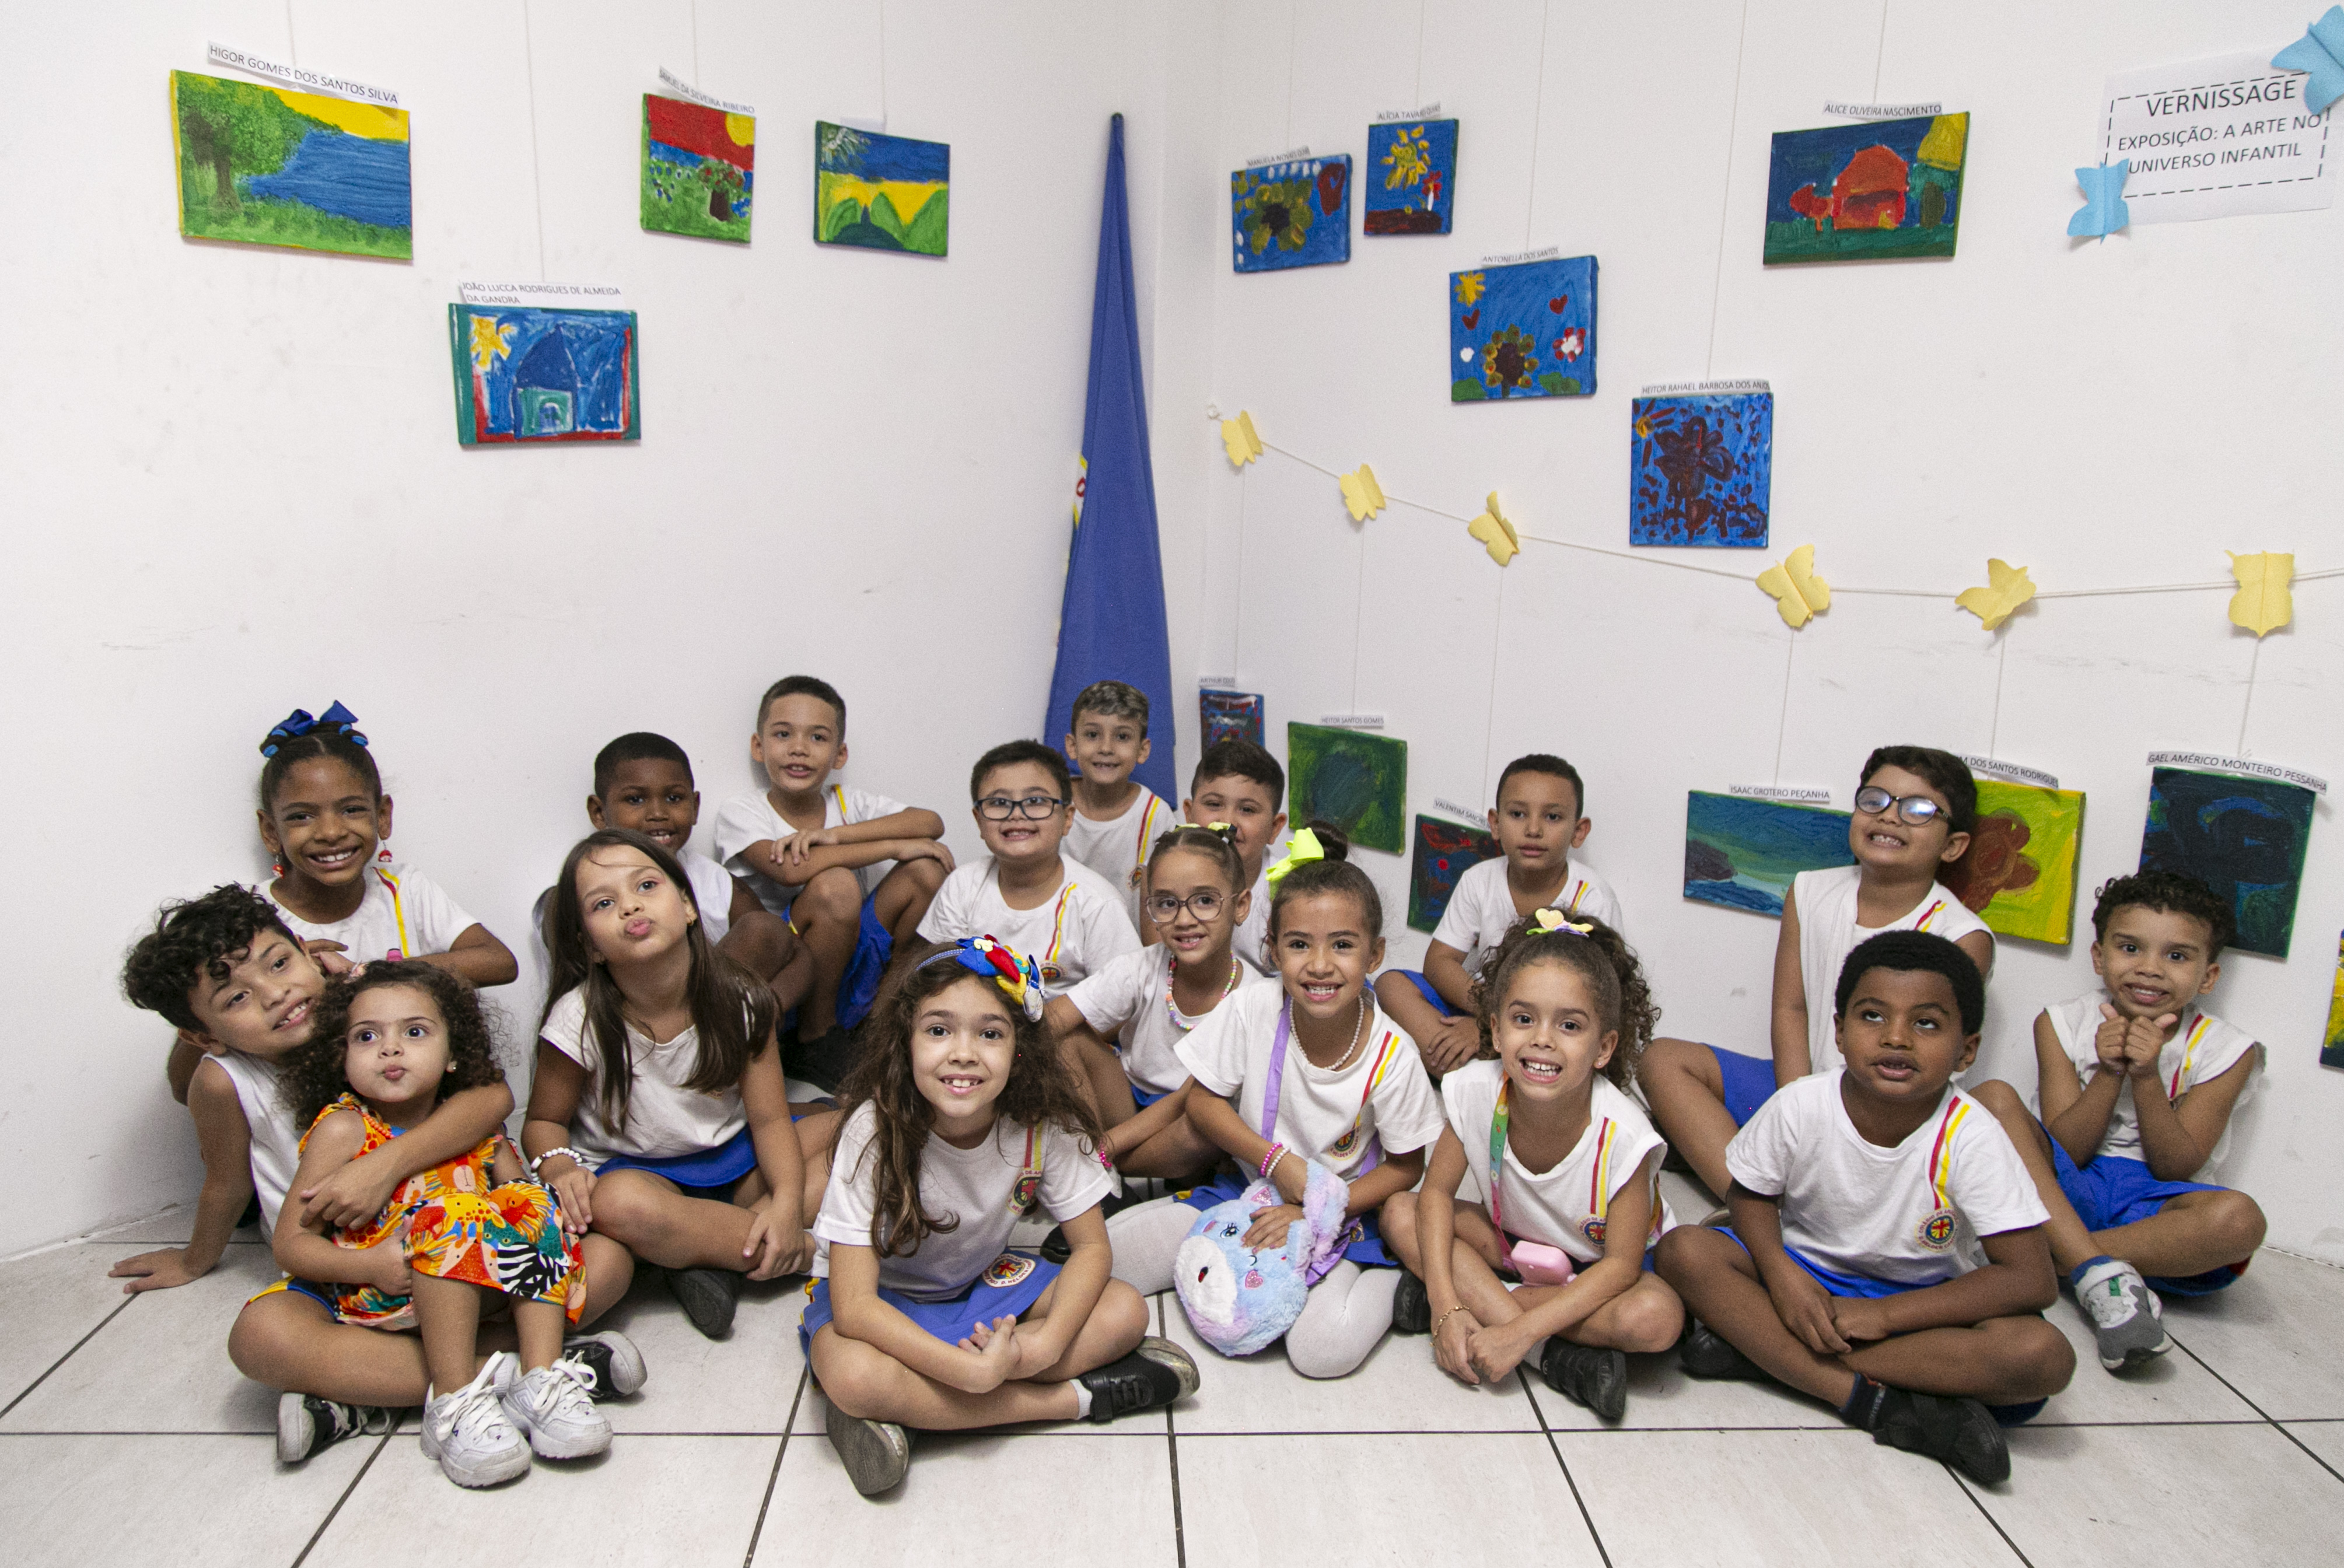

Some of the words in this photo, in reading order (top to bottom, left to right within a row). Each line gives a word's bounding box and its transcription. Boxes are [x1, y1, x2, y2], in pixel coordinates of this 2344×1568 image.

[209, 45, 244, 65] HIGOR
[248, 58, 291, 78] GOMES
[295, 69, 318, 85] DOS
[321, 76, 365, 96] SANTOS
[368, 88, 398, 104] SILVA
[690, 89, 720, 107] SILVEIRA
[723, 100, 755, 114] RIBEIRO
[2146, 79, 2297, 117] VERNISSAGE
[1824, 103, 1847, 114] ALICE
[1849, 104, 1881, 116] OLIVEIRA
[1883, 104, 1941, 117] NASCIMENTO
[2118, 125, 2217, 151] EXPOSIÇÃO:
[2223, 124, 2235, 139] A
[2240, 117, 2287, 137] ARTE
[2292, 114, 2321, 131] NO
[1247, 156, 1275, 167] MANUELA
[2128, 152, 2216, 174] UNIVERSO
[2221, 142, 2301, 165] INFANTIL
[1482, 254, 1522, 262] ANTONELLA
[1524, 251, 1535, 261] DOS
[1537, 247, 1559, 258] SANTOS
[462, 282, 485, 291] JOÃO
[519, 285, 568, 295] RODRIGUES
[571, 286, 582, 295] DE
[583, 286, 621, 296] ALMEIDA
[466, 294, 480, 302] DA
[481, 295, 521, 304] GANDRA
[1642, 385, 1666, 394] HEITOR
[1699, 381, 1734, 390] BARBOSA
[1736, 380, 1751, 389] DOS
[1971, 758, 1986, 768] DOS
[1988, 761, 2018, 775] SANTOS
[2020, 768, 2059, 788] RODRIGUES
[2148, 754, 2168, 763] GAEL
[2171, 752, 2219, 766] AMÉRICO
[2221, 758, 2282, 776] MONTEIRO
[2284, 771, 2326, 790] PESSANHA
[1731, 786, 1752, 794] ISAAC
[1754, 787, 1789, 797] GROTERO
[1791, 790, 1829, 799] PEÇANHA
[1435, 800, 1465, 816] VALENTIM
